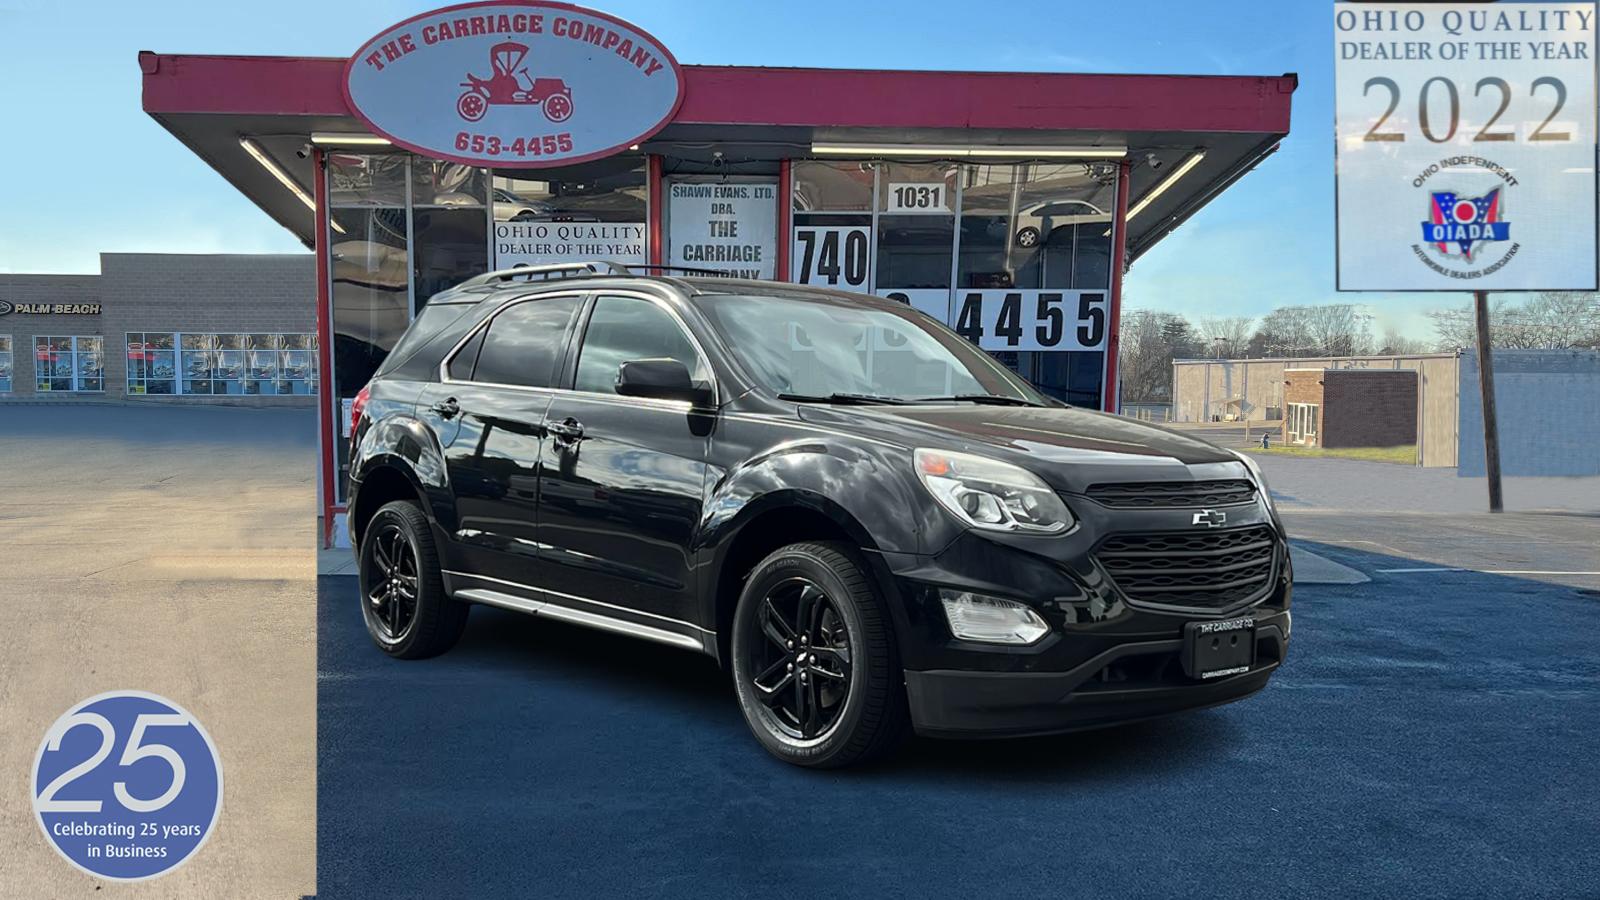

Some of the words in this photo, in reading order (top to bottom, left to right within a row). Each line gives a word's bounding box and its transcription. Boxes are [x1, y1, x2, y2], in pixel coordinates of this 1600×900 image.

[1336, 10, 1425, 32] OHIO
[1442, 10, 1593, 36] QUALITY
[365, 33, 417, 72] THE
[422, 14, 544, 46] CARRIAGE
[552, 17, 664, 77] COMPANY
[1340, 42, 1433, 60] DEALER
[1438, 42, 1469, 60] OF
[1475, 42, 1522, 60] THE
[1527, 42, 1589, 60] YEAR
[1362, 76, 1571, 143] 2022
[454, 132, 574, 156] 653-4455
[1412, 163, 1439, 188] OHIO
[1440, 155, 1519, 187] INDEPENDENT
[672, 186, 712, 198] SHAWN
[753, 187, 775, 199] LTD.
[894, 186, 941, 209] 1031
[711, 203, 736, 215] DBA.
[497, 225, 548, 239] OHIO
[557, 226, 644, 241] QUALITY
[708, 220, 738, 238] THE
[1432, 224, 1495, 241] OIADA
[499, 243, 552, 255] DEALER
[555, 244, 573, 254] OF
[576, 244, 603, 255] THE
[607, 244, 642, 255] YEAR
[682, 244, 762, 262] CARRIAGE
[797, 229, 869, 286] 740
[1411, 244, 1449, 277] AUTOMOBILE
[1449, 270, 1482, 280] DEALERS
[1483, 242, 1521, 276] ASSOCIATION
[14, 303, 51, 314] PALM
[54, 303, 100, 314] BEACH
[956, 292, 1106, 347] 4455
